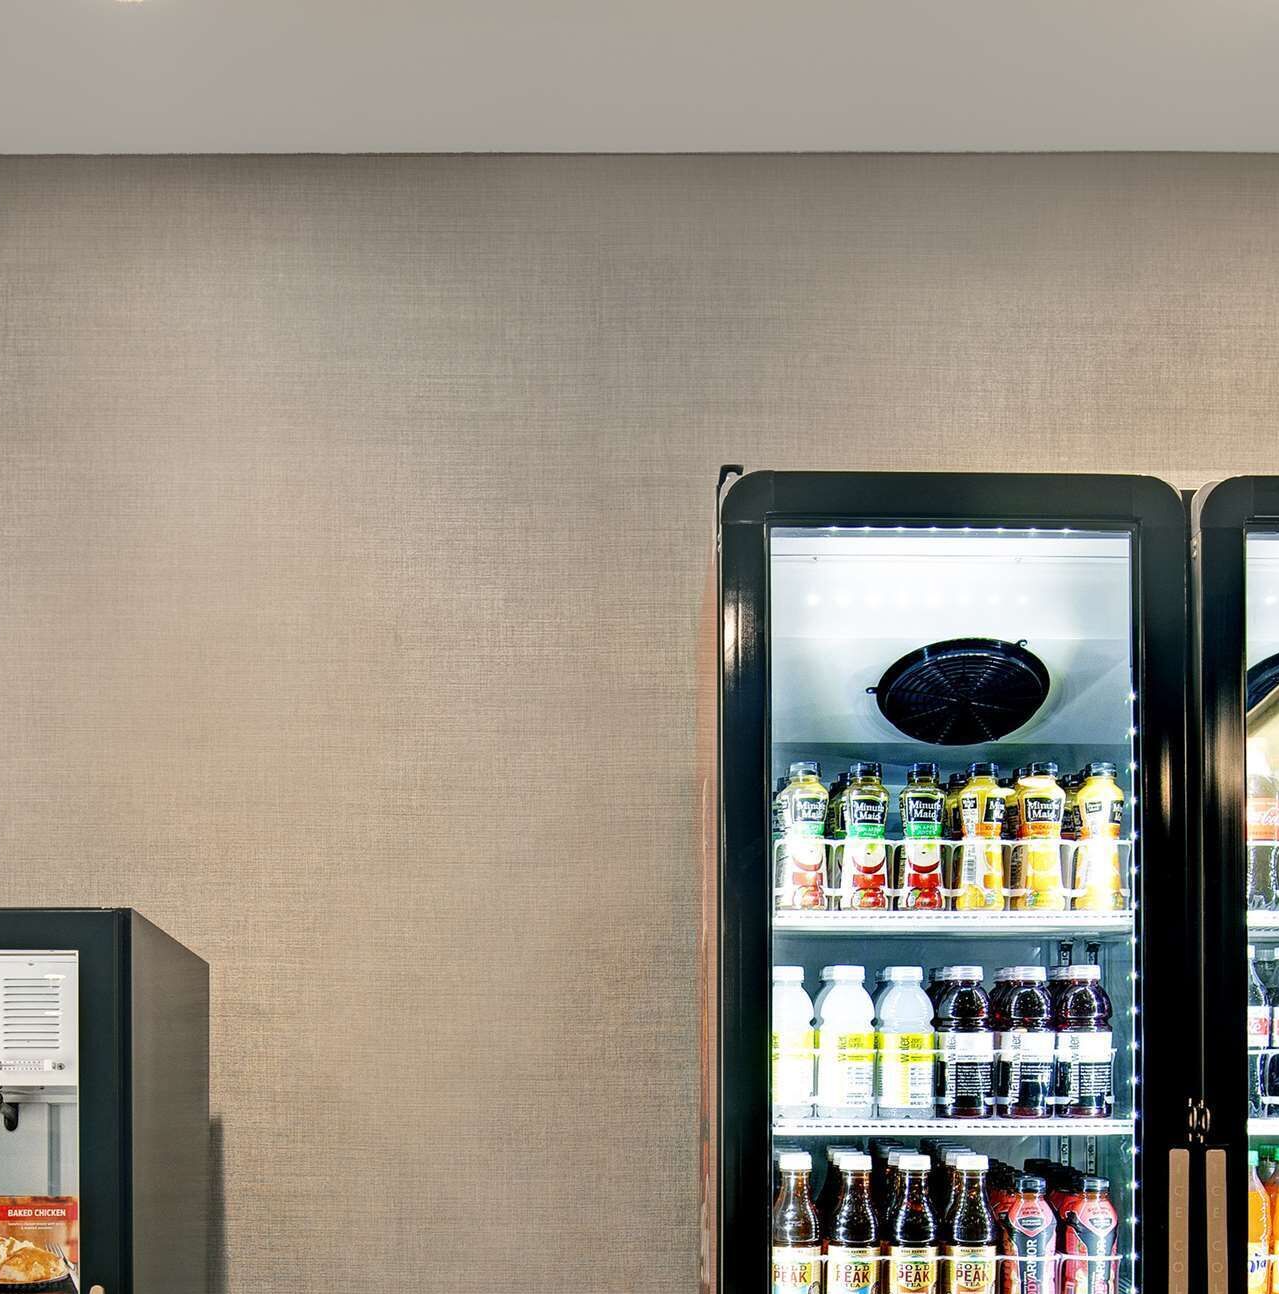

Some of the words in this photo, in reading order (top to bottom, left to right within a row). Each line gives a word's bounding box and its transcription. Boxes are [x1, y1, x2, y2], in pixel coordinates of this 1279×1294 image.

[7, 1209, 33, 1217] BAKED
[34, 1209, 67, 1217] CHICKEN
[898, 1271, 930, 1283] PEAK
